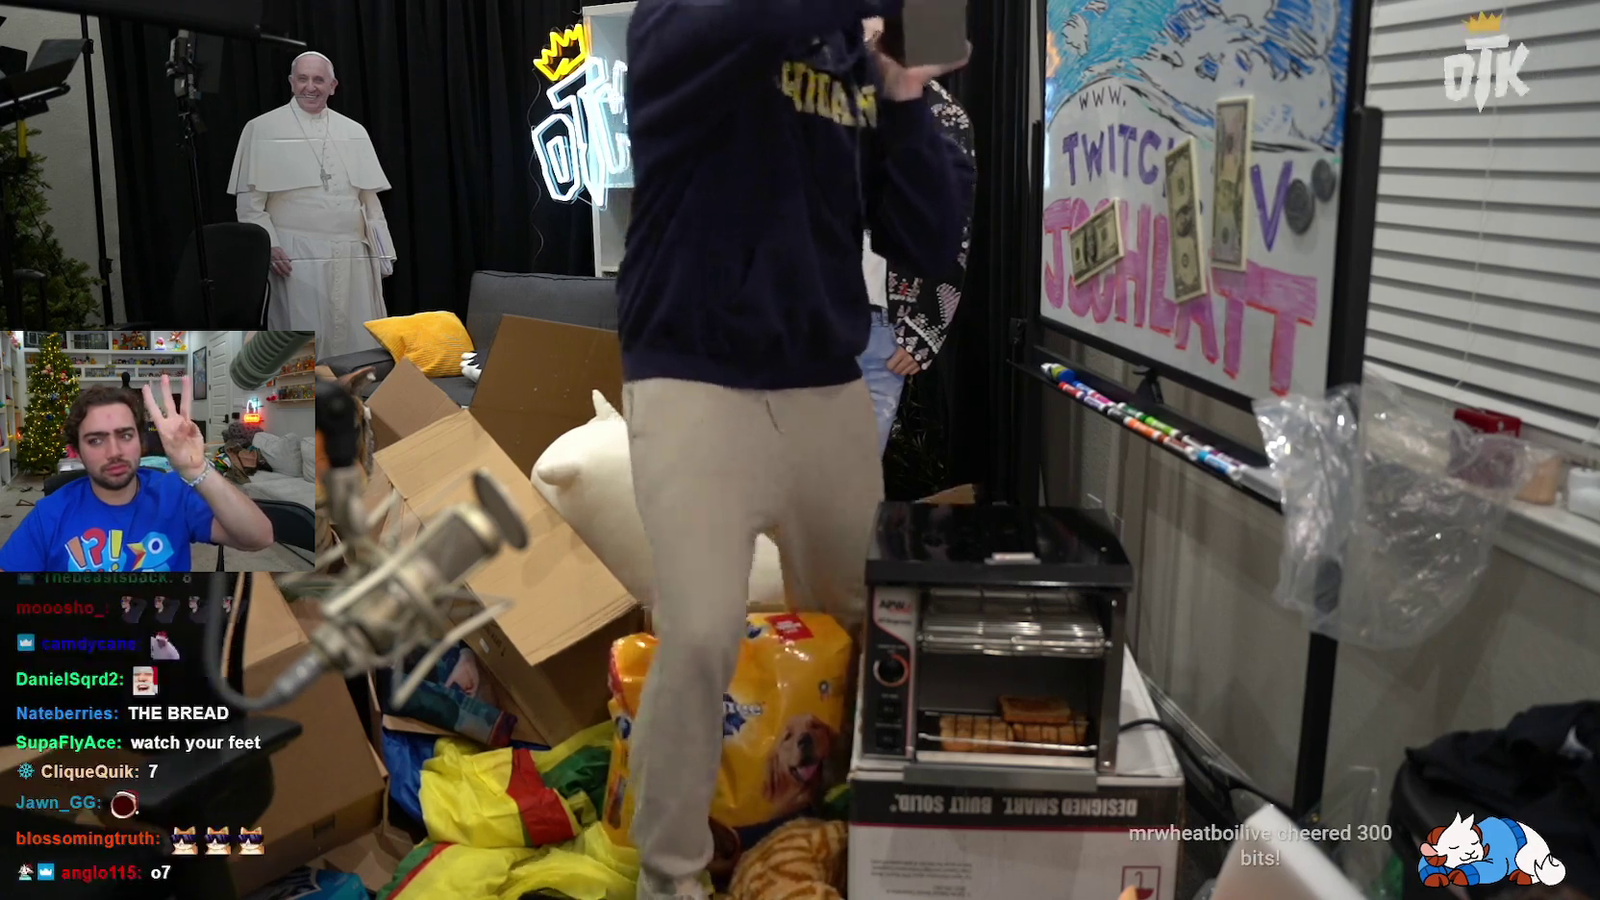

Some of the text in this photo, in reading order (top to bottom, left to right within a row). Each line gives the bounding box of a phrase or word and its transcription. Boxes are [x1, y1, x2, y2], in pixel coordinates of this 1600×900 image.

[949, 795, 993, 815] BUILT
[1001, 796, 1060, 816] SMART.
[1061, 797, 1139, 818] DESIGNED
